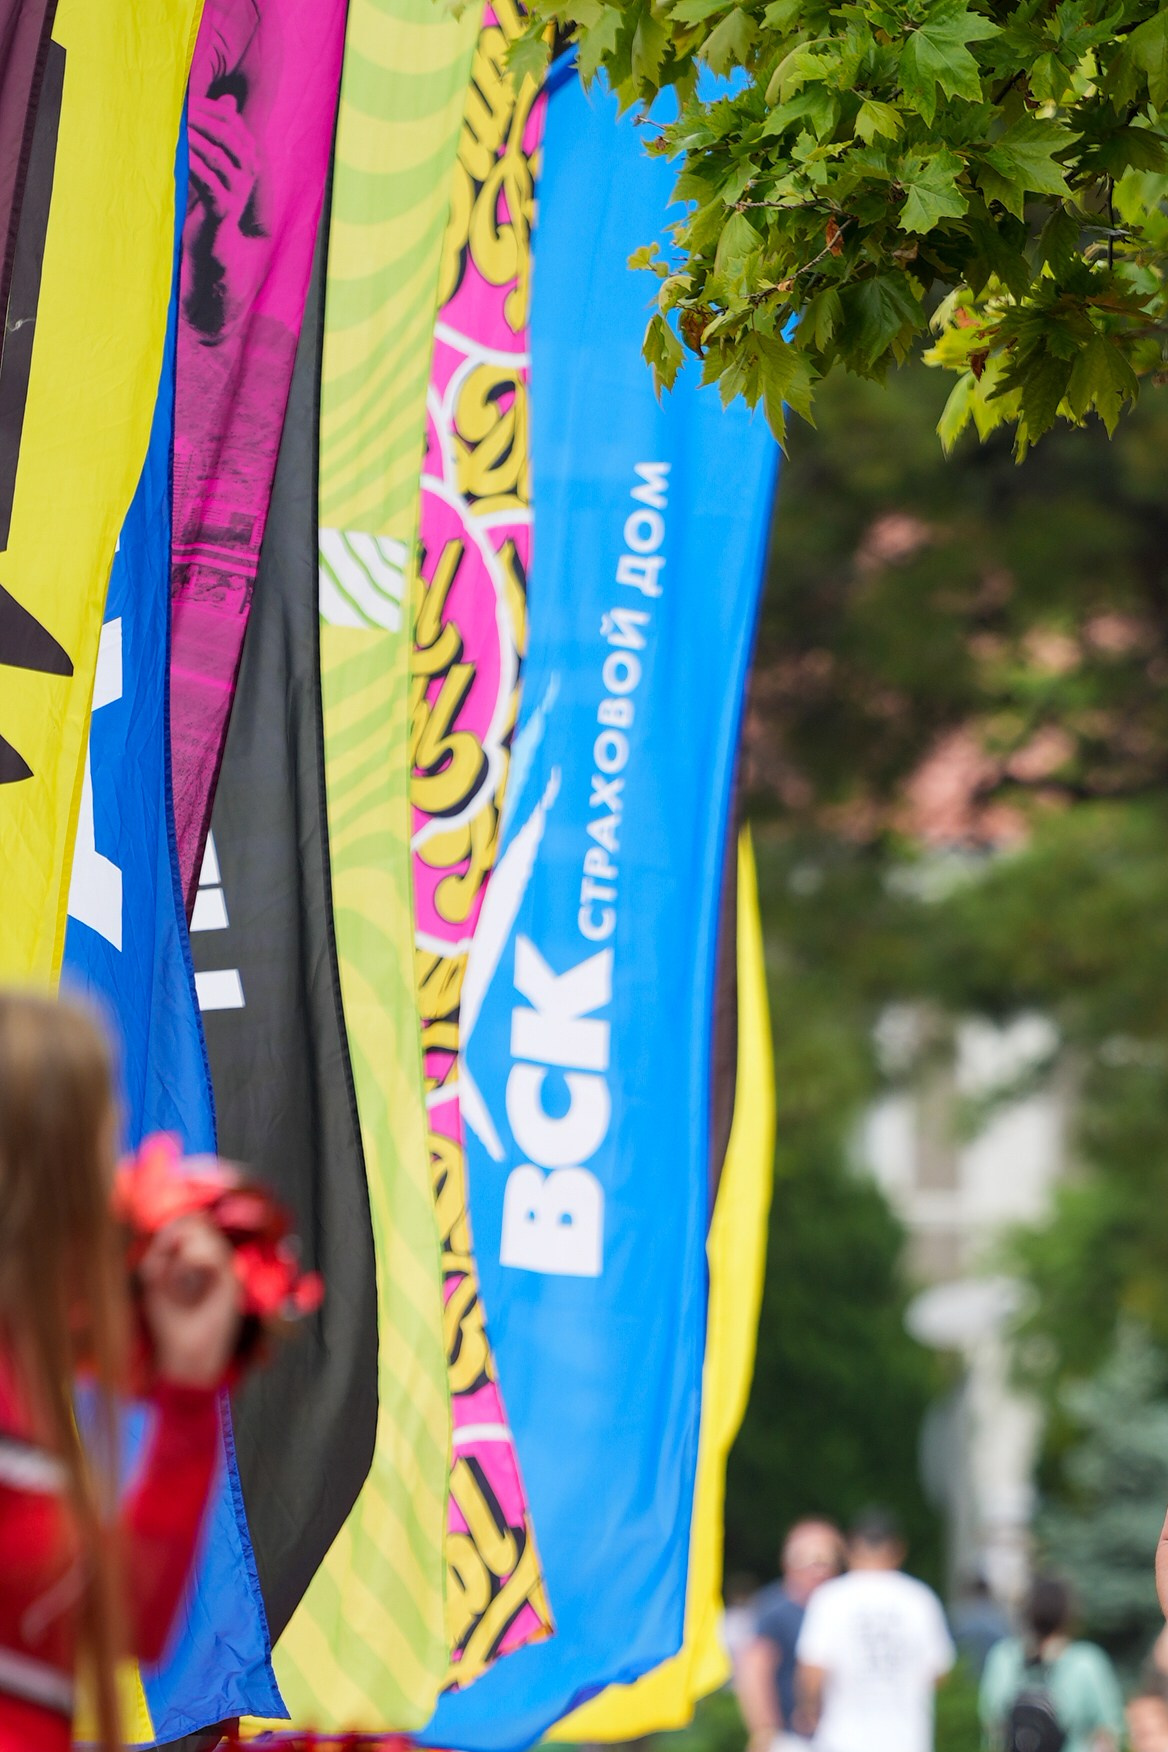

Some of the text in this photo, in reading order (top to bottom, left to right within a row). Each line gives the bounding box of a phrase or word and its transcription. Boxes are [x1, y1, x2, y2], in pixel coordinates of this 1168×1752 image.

[577, 461, 672, 942] СТРАХОВОЙ ДОМ
[499, 932, 616, 1278] ВСК
